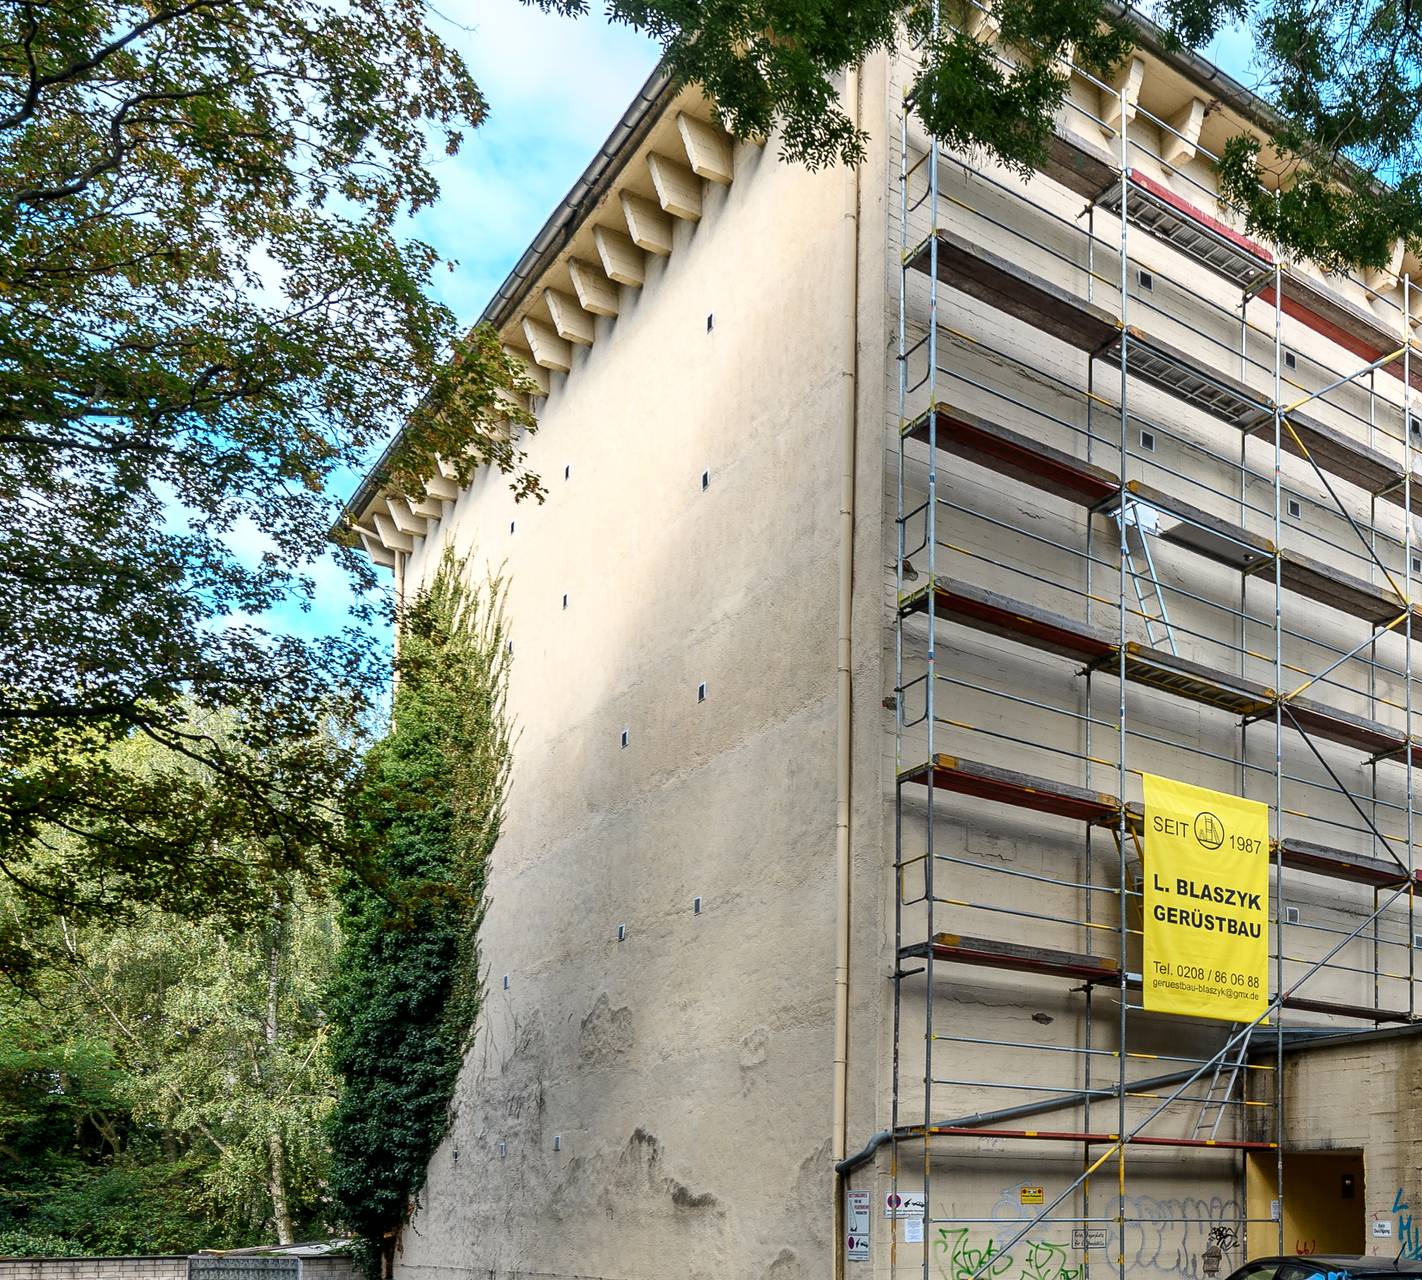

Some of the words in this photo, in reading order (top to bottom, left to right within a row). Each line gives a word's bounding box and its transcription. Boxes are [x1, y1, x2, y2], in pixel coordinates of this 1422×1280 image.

[1153, 816, 1189, 838] SEIT
[1230, 835, 1262, 855] 1987
[1154, 873, 1170, 893] L.
[1176, 878, 1262, 911] BLASZYK
[1153, 904, 1262, 938] GERÜSTBAU
[1152, 979, 1259, 1001] geruestbau-blaszyk@gmx.de
[1153, 960, 1174, 976] Tel.
[1176, 965, 1205, 981] 0208
[1207, 969, 1213, 982] /
[1214, 970, 1228, 984] 86
[1230, 973, 1245, 986] 06
[1247, 975, 1260, 989] 88
